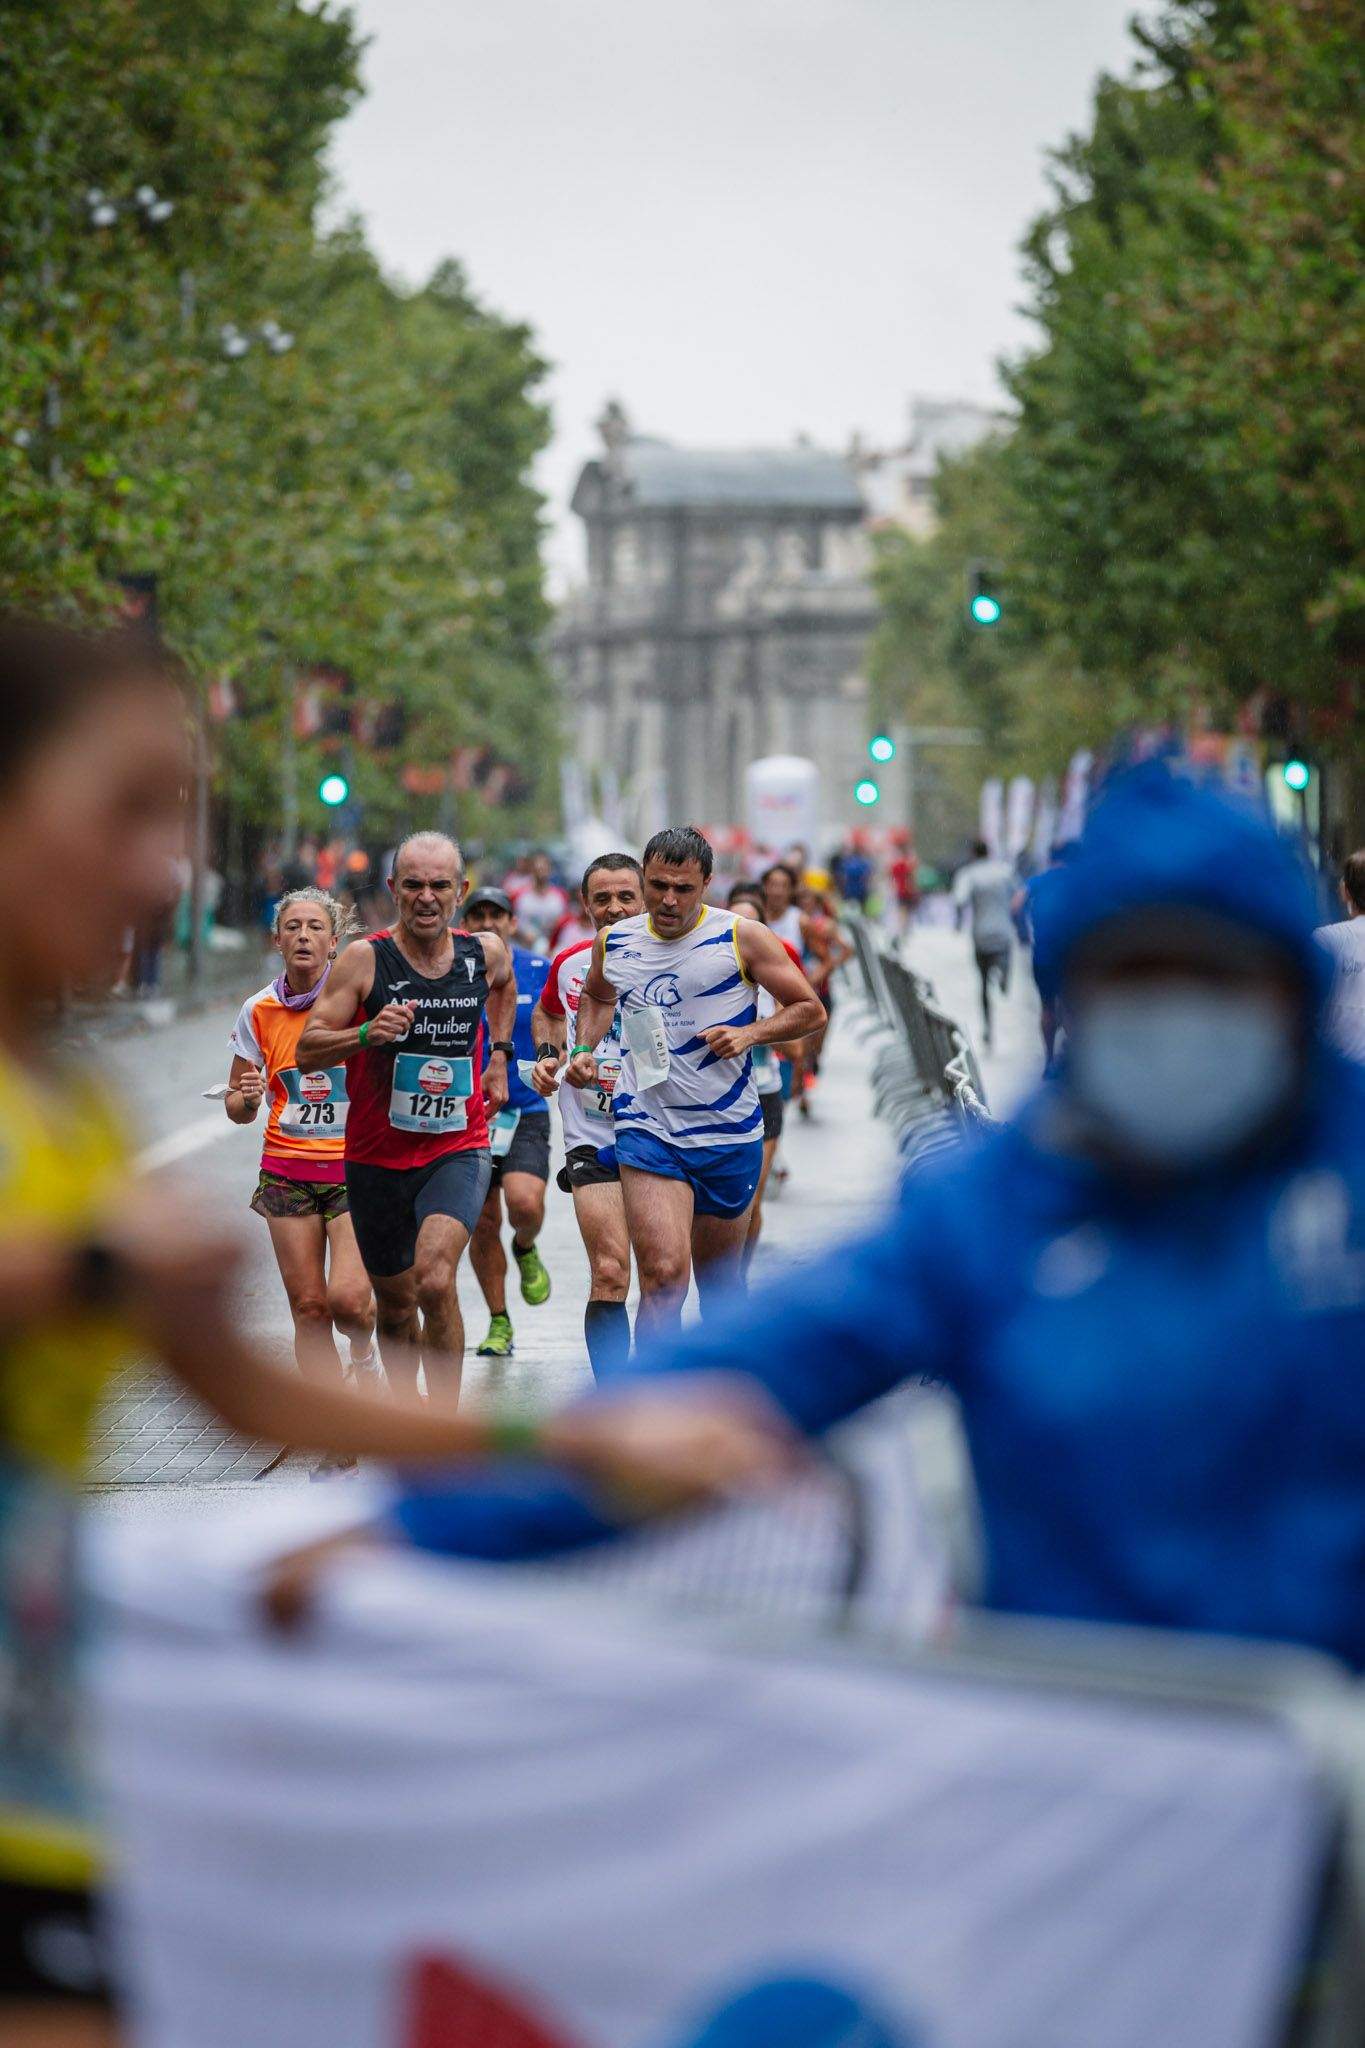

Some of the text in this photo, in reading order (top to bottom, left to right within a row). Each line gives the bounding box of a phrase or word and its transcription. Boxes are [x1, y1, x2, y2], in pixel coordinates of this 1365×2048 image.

[416, 997, 478, 1008] MARATHON
[414, 1015, 472, 1042] alquiber
[299, 1103, 335, 1125] 273
[409, 1094, 456, 1118] 1215
